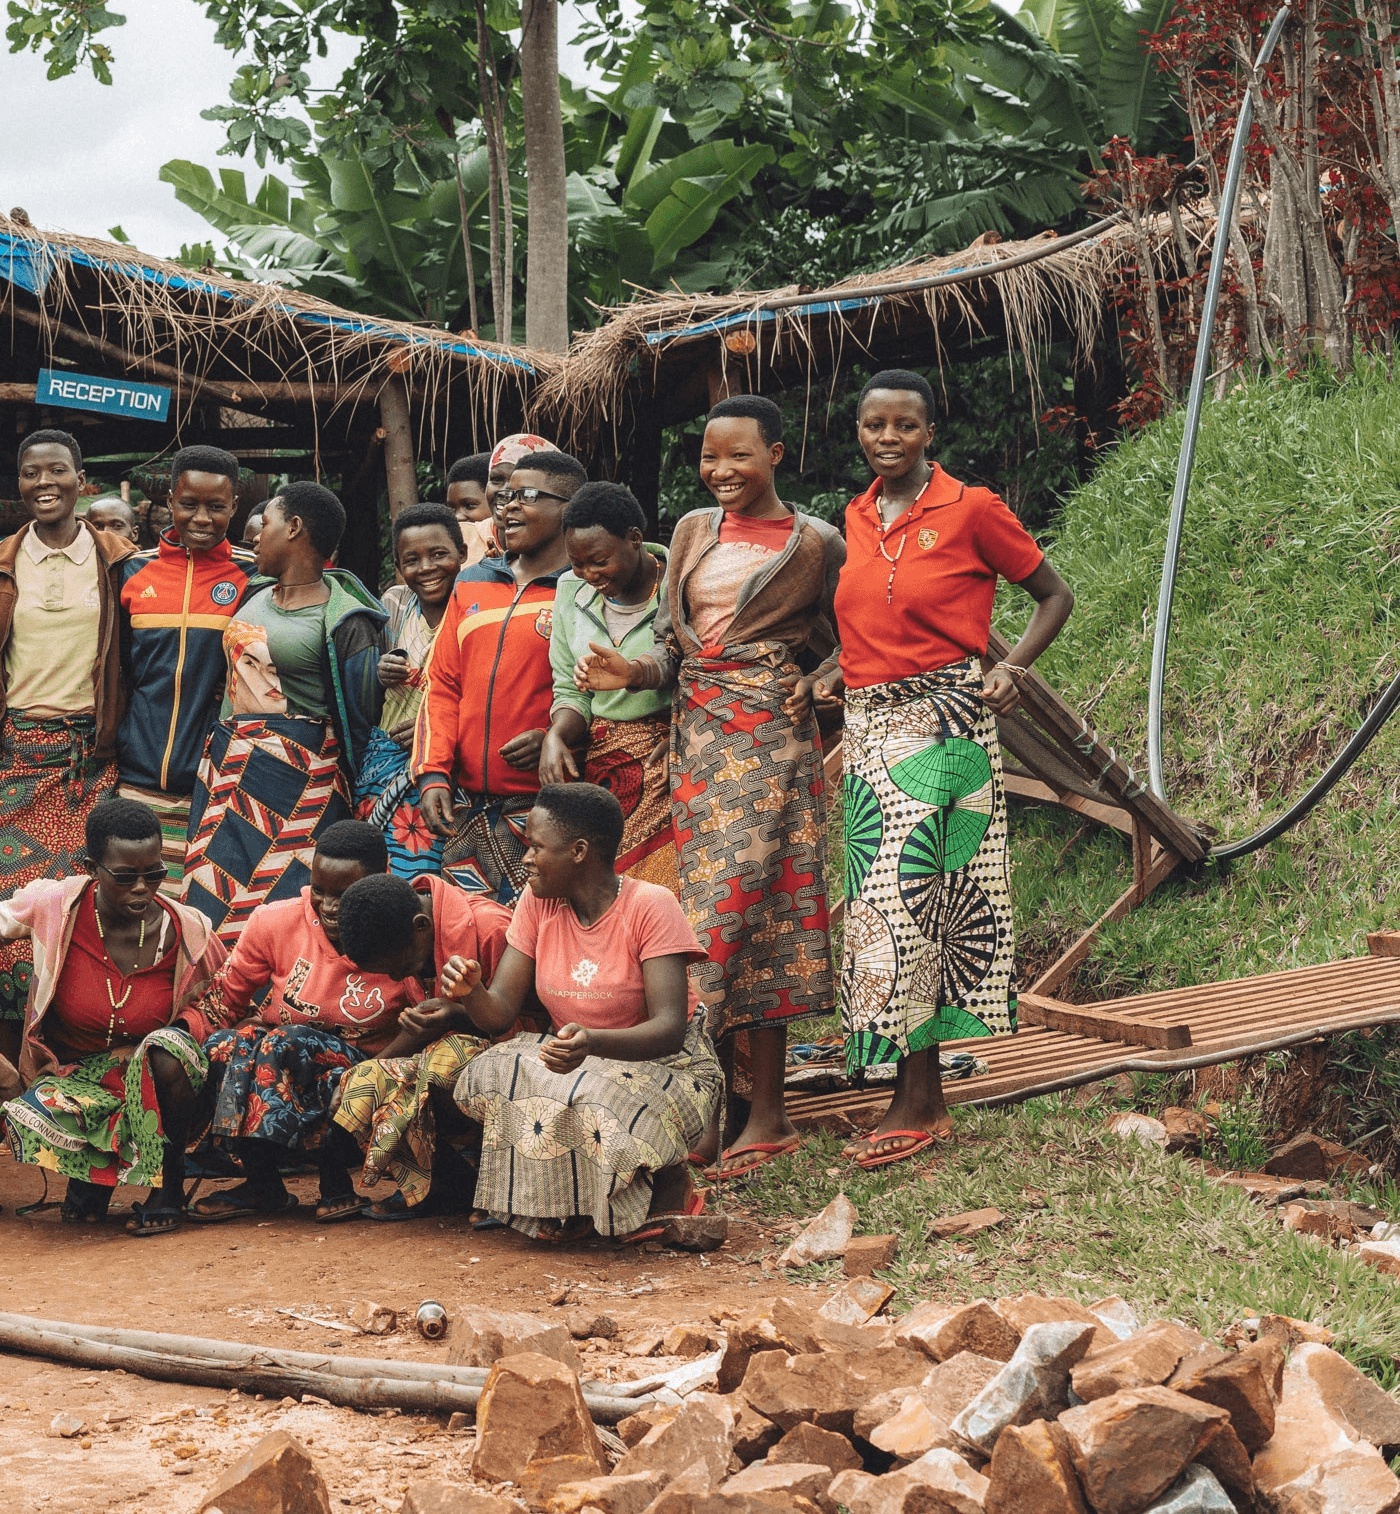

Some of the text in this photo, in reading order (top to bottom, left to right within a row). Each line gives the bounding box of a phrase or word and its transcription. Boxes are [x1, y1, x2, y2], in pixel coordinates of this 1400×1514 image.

[49, 379, 162, 412] RECEPTION
[546, 987, 614, 1000] SNAPPERROCK
[12, 1106, 29, 1122] SEUL
[29, 1117, 63, 1143] CONNAIT
